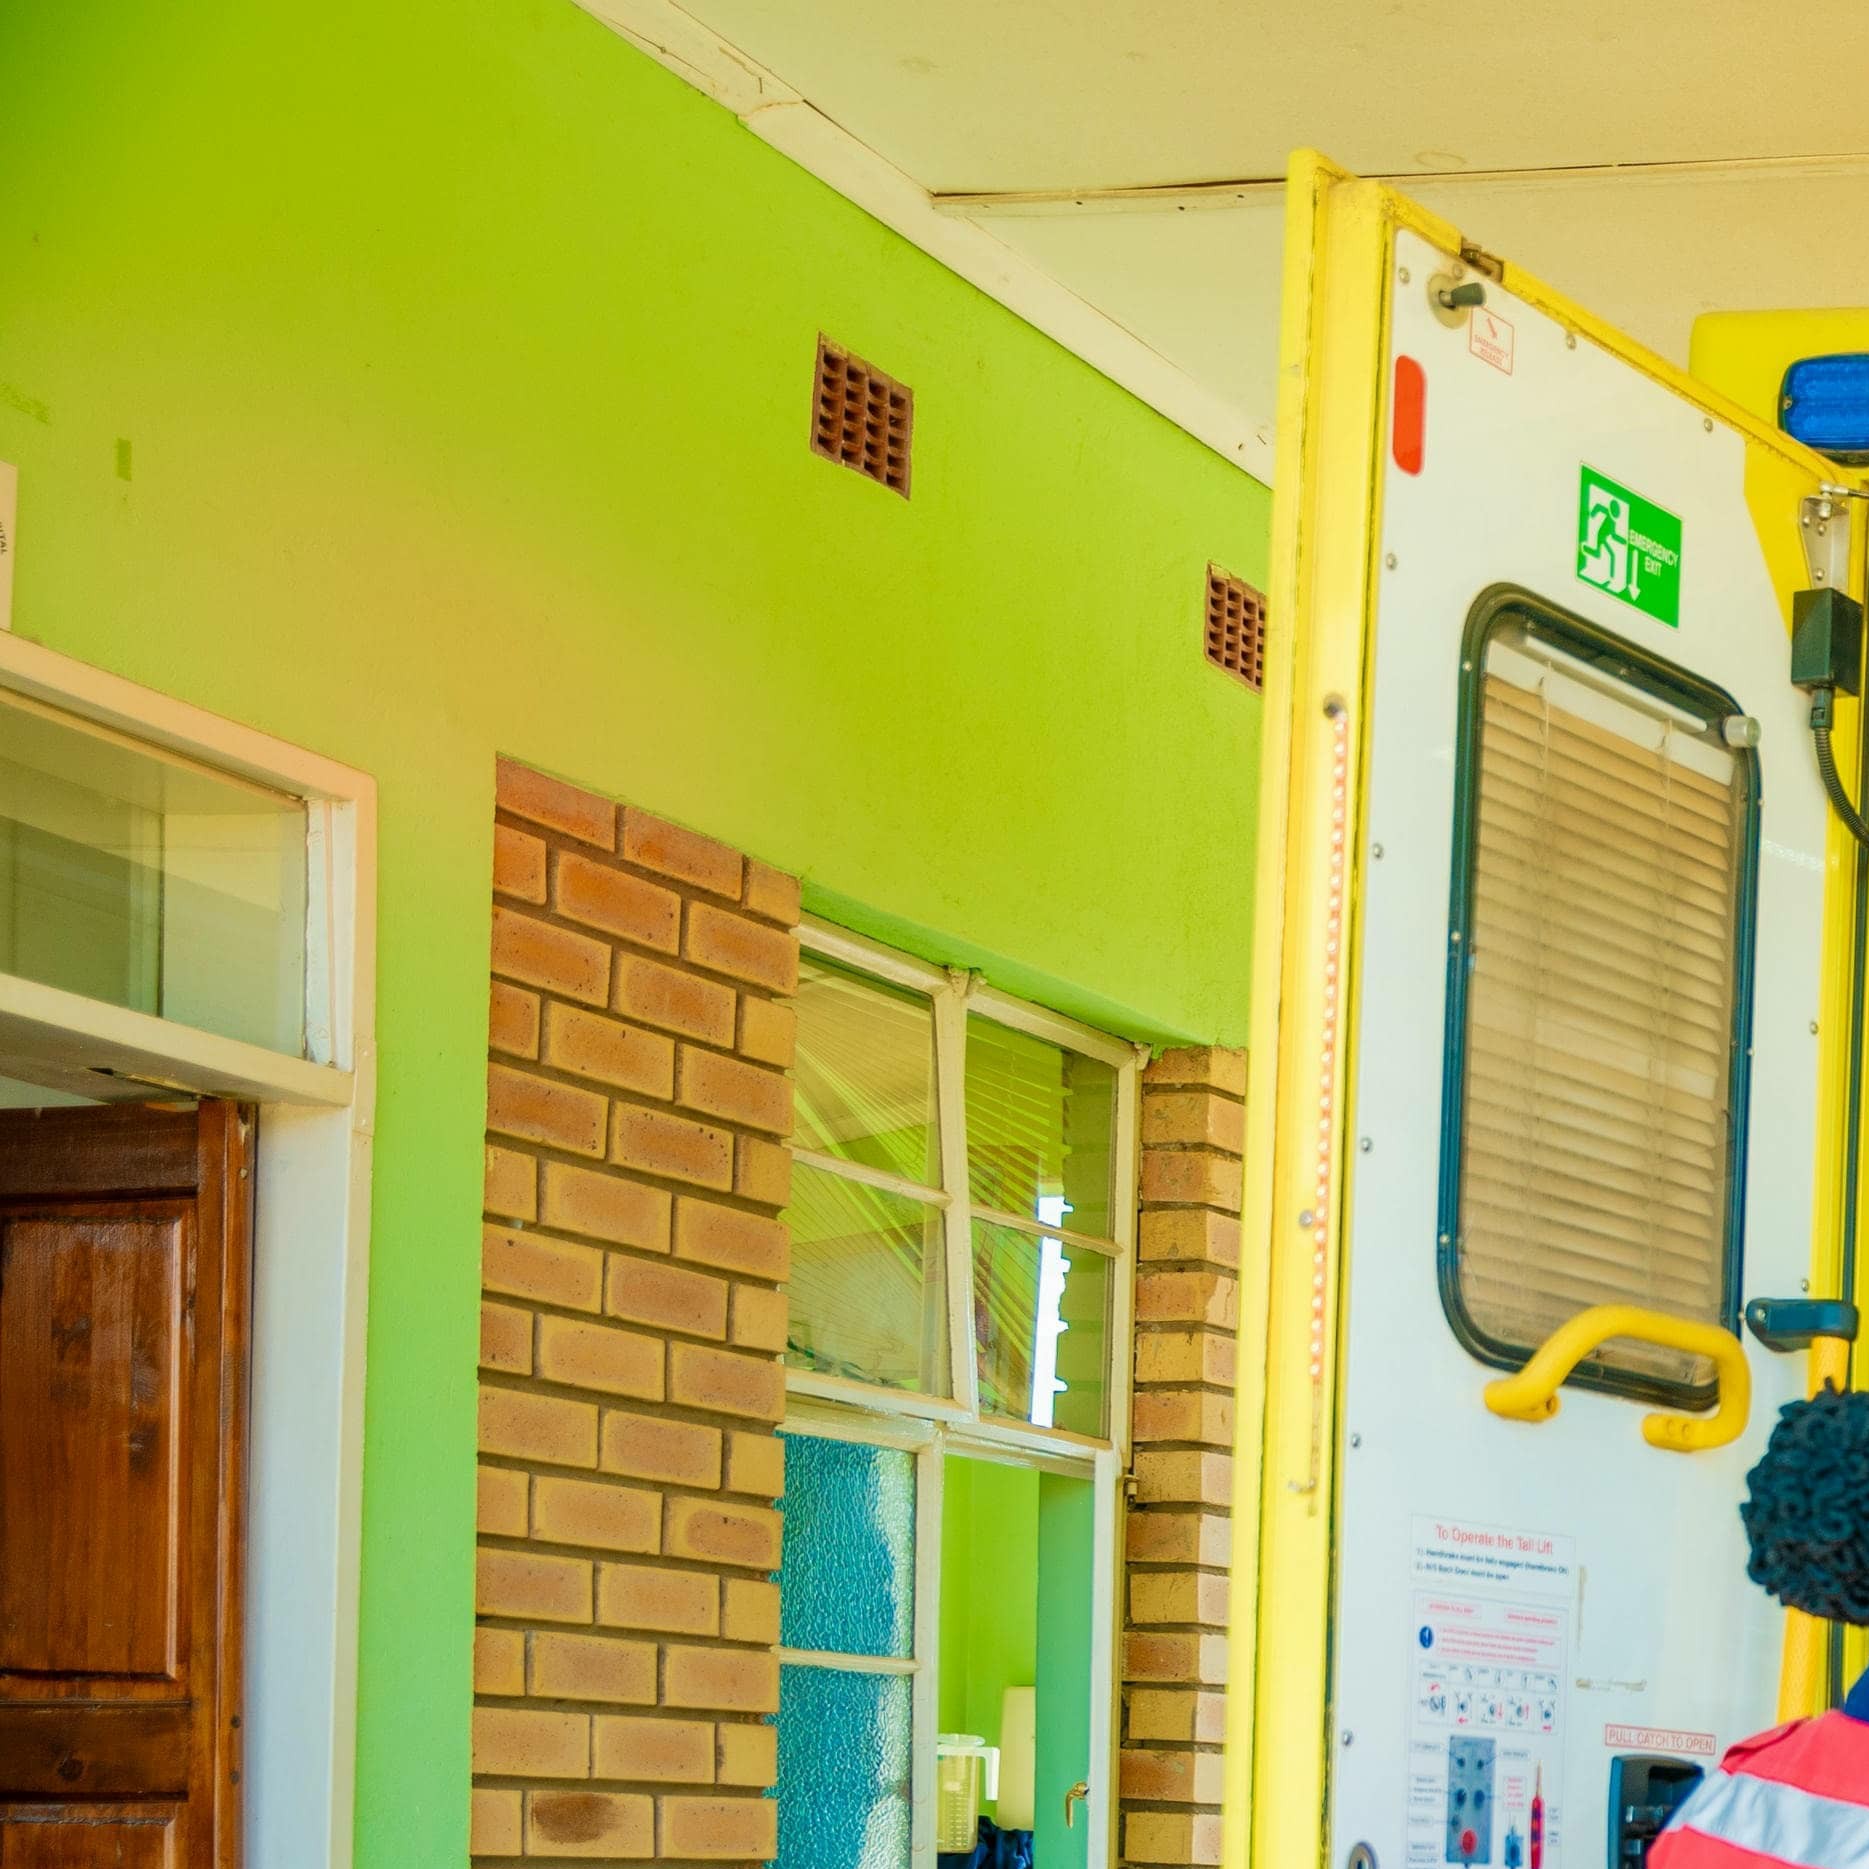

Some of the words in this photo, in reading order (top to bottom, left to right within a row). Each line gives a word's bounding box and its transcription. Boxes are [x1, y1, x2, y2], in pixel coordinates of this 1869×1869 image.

[1629, 529, 1679, 568] EMERGENCY
[1644, 555, 1662, 577] EXIT
[1436, 1524, 1448, 1540] To
[1452, 1528, 1493, 1546] Operate
[1498, 1534, 1513, 1550] the
[1517, 1536, 1533, 1551] Tail
[1537, 1538, 1553, 1555] Lift
[1609, 1727, 1632, 1743] PULL
[1671, 1734, 1683, 1749] TO
[1686, 1737, 1713, 1751] OPEN
